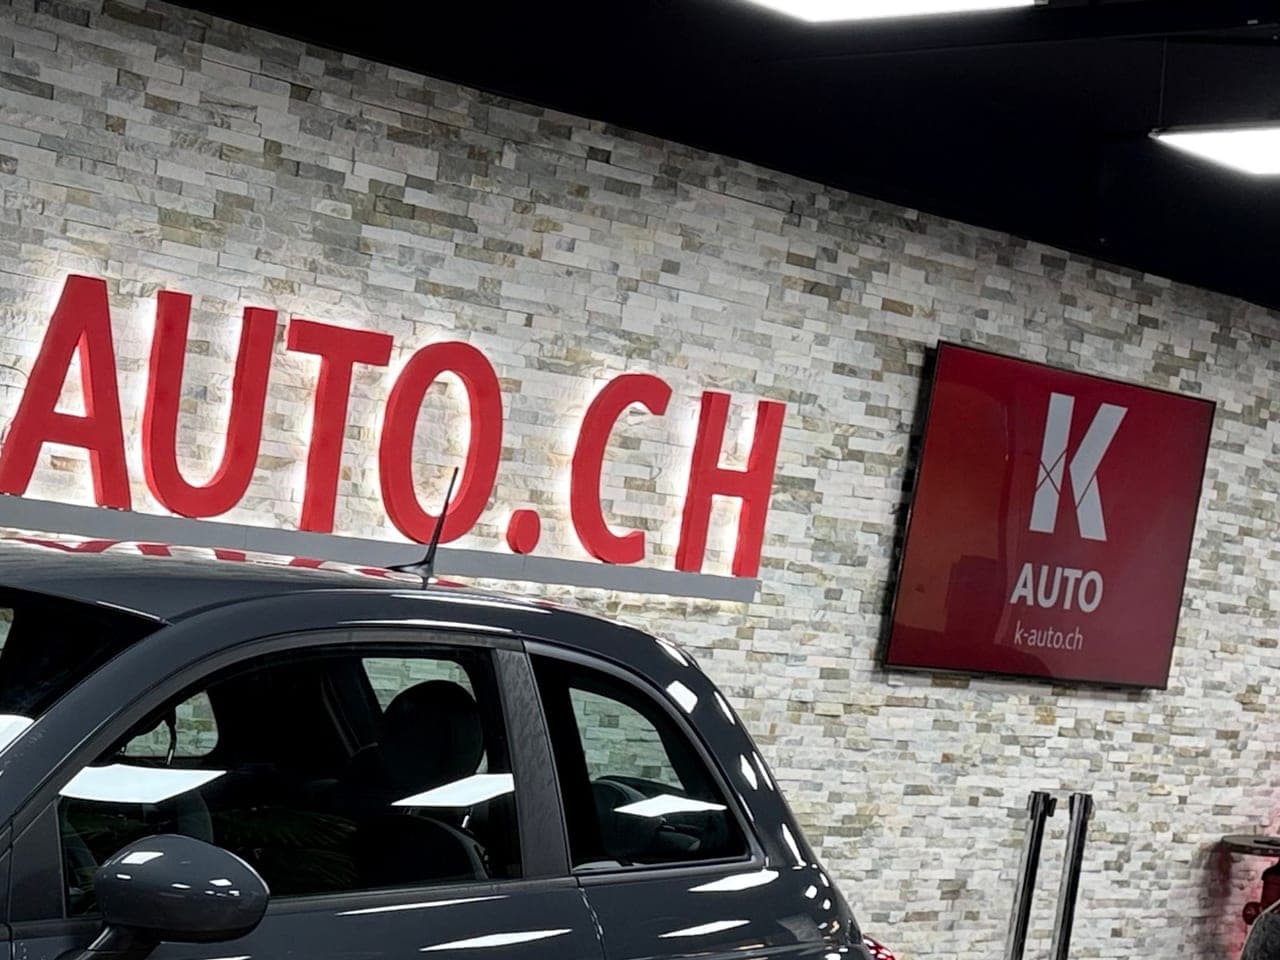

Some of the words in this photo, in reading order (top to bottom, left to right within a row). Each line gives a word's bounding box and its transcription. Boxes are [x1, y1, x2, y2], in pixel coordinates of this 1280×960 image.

[1028, 391, 1129, 542] K
[1009, 562, 1104, 614] AUTO
[1013, 620, 1084, 651] k-auto.ch
